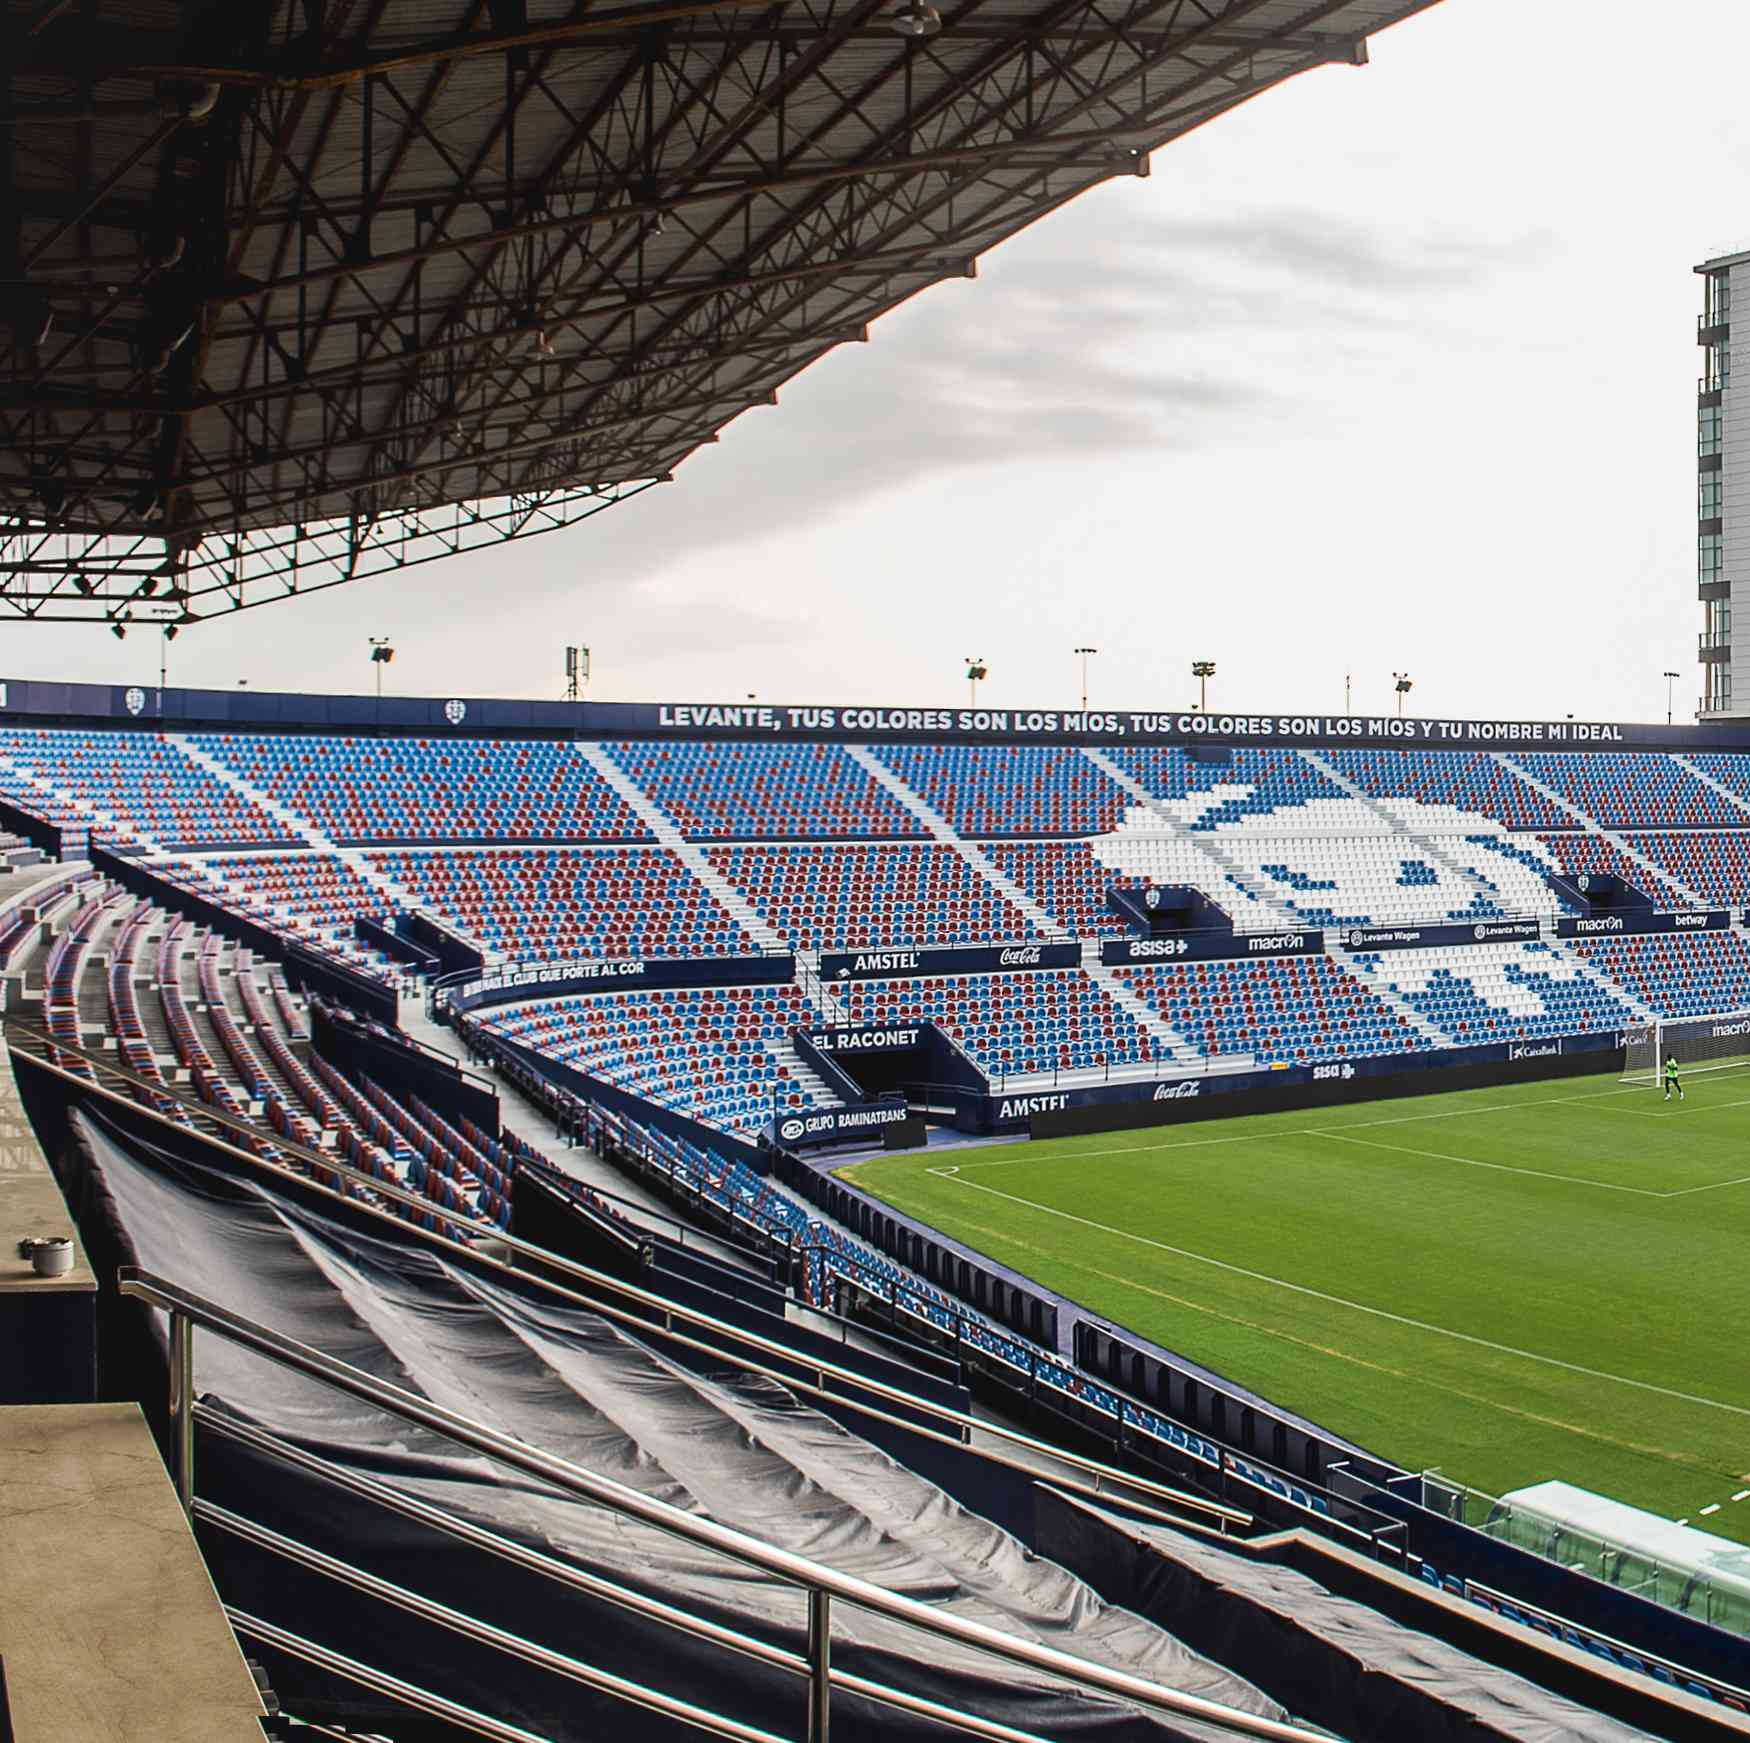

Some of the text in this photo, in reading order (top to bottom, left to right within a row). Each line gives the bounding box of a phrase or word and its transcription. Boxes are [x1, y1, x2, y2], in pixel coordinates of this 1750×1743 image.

[659, 706, 1623, 741] LEVANTE, TUS COLORES SON LOS MÍOS, TUS COLORES SON LOS MÍOS Y TU NOMBRE MI IDEAL
[1576, 915, 1623, 932] macron
[1675, 914, 1708, 928] betway
[1363, 930, 1393, 942] Levante
[1485, 926, 1512, 938] Levante
[1129, 940, 1175, 956] asisa
[1248, 934, 1303, 951] macron
[854, 952, 920, 971] AMSTEL
[562, 964, 599, 980] PORTE
[601, 963, 617, 977] AL
[618, 962, 645, 975] COR
[812, 1030, 919, 1051] EL RACONET
[805, 1107, 907, 1134] GRUPO RAMINATRANS
